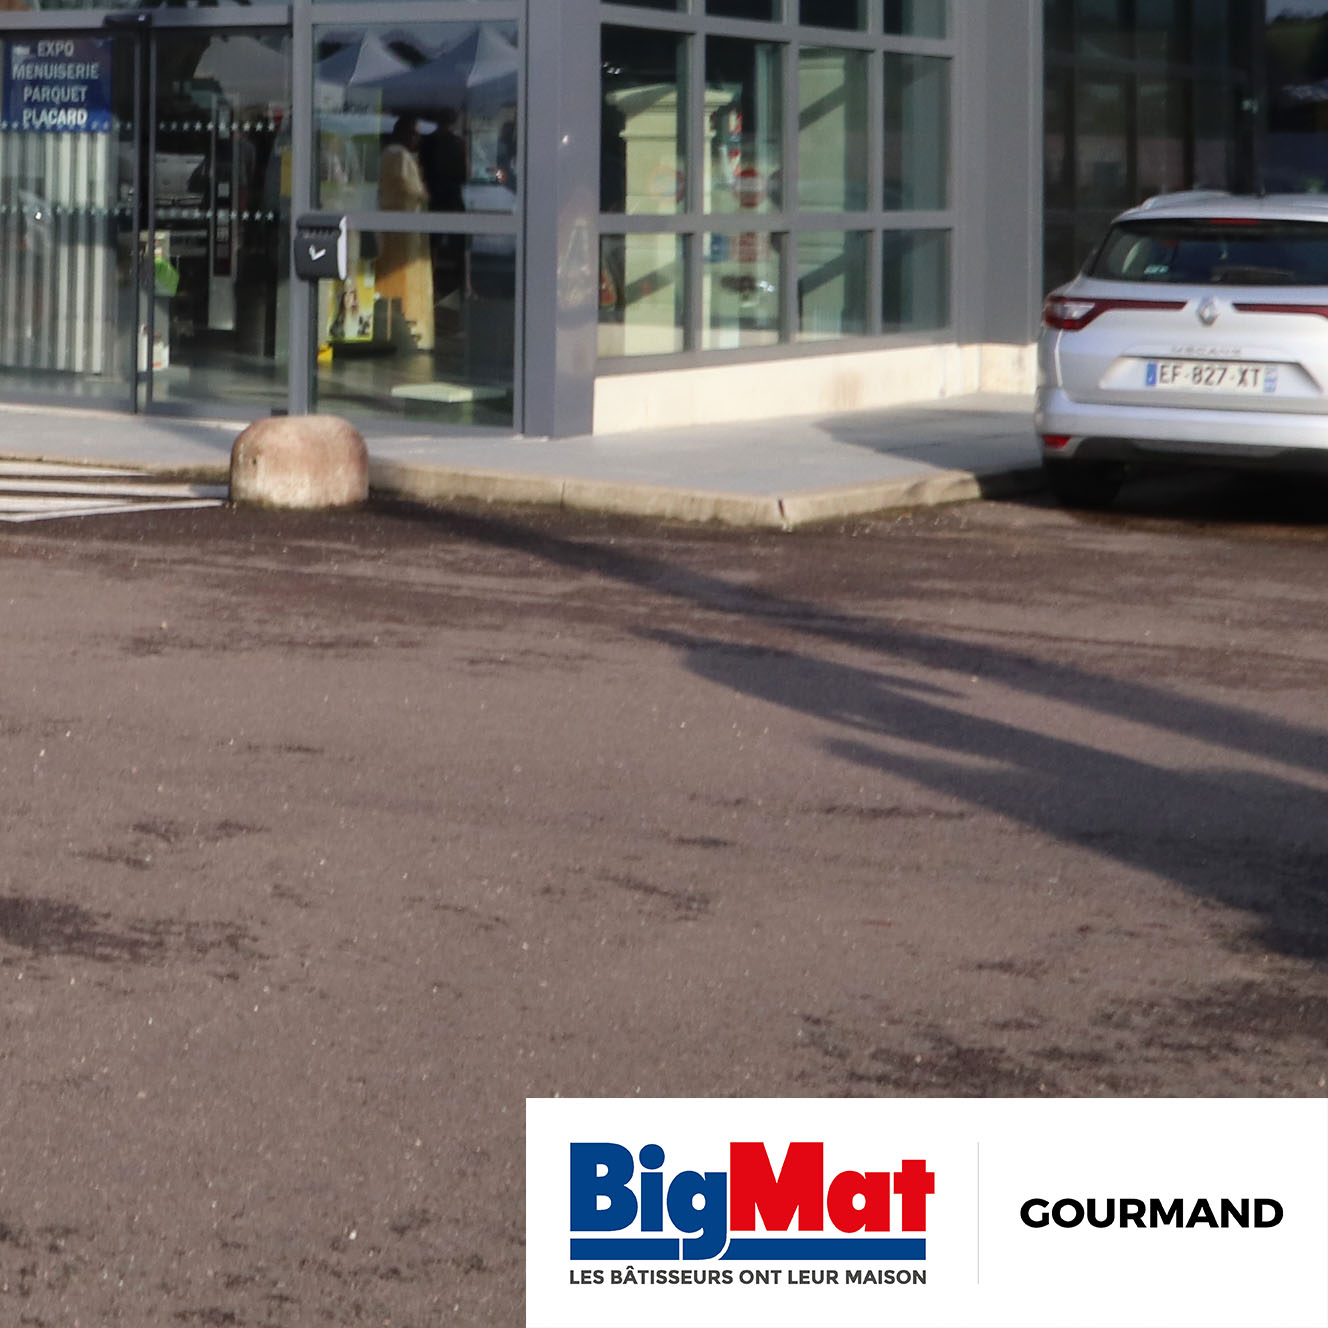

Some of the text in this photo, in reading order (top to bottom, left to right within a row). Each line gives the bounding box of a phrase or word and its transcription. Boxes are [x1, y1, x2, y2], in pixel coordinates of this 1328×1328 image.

[37, 39, 75, 57] EXPO
[11, 61, 101, 81] MENUISERIE
[23, 84, 88, 105] PARQUET
[22, 106, 89, 127] PLACARD
